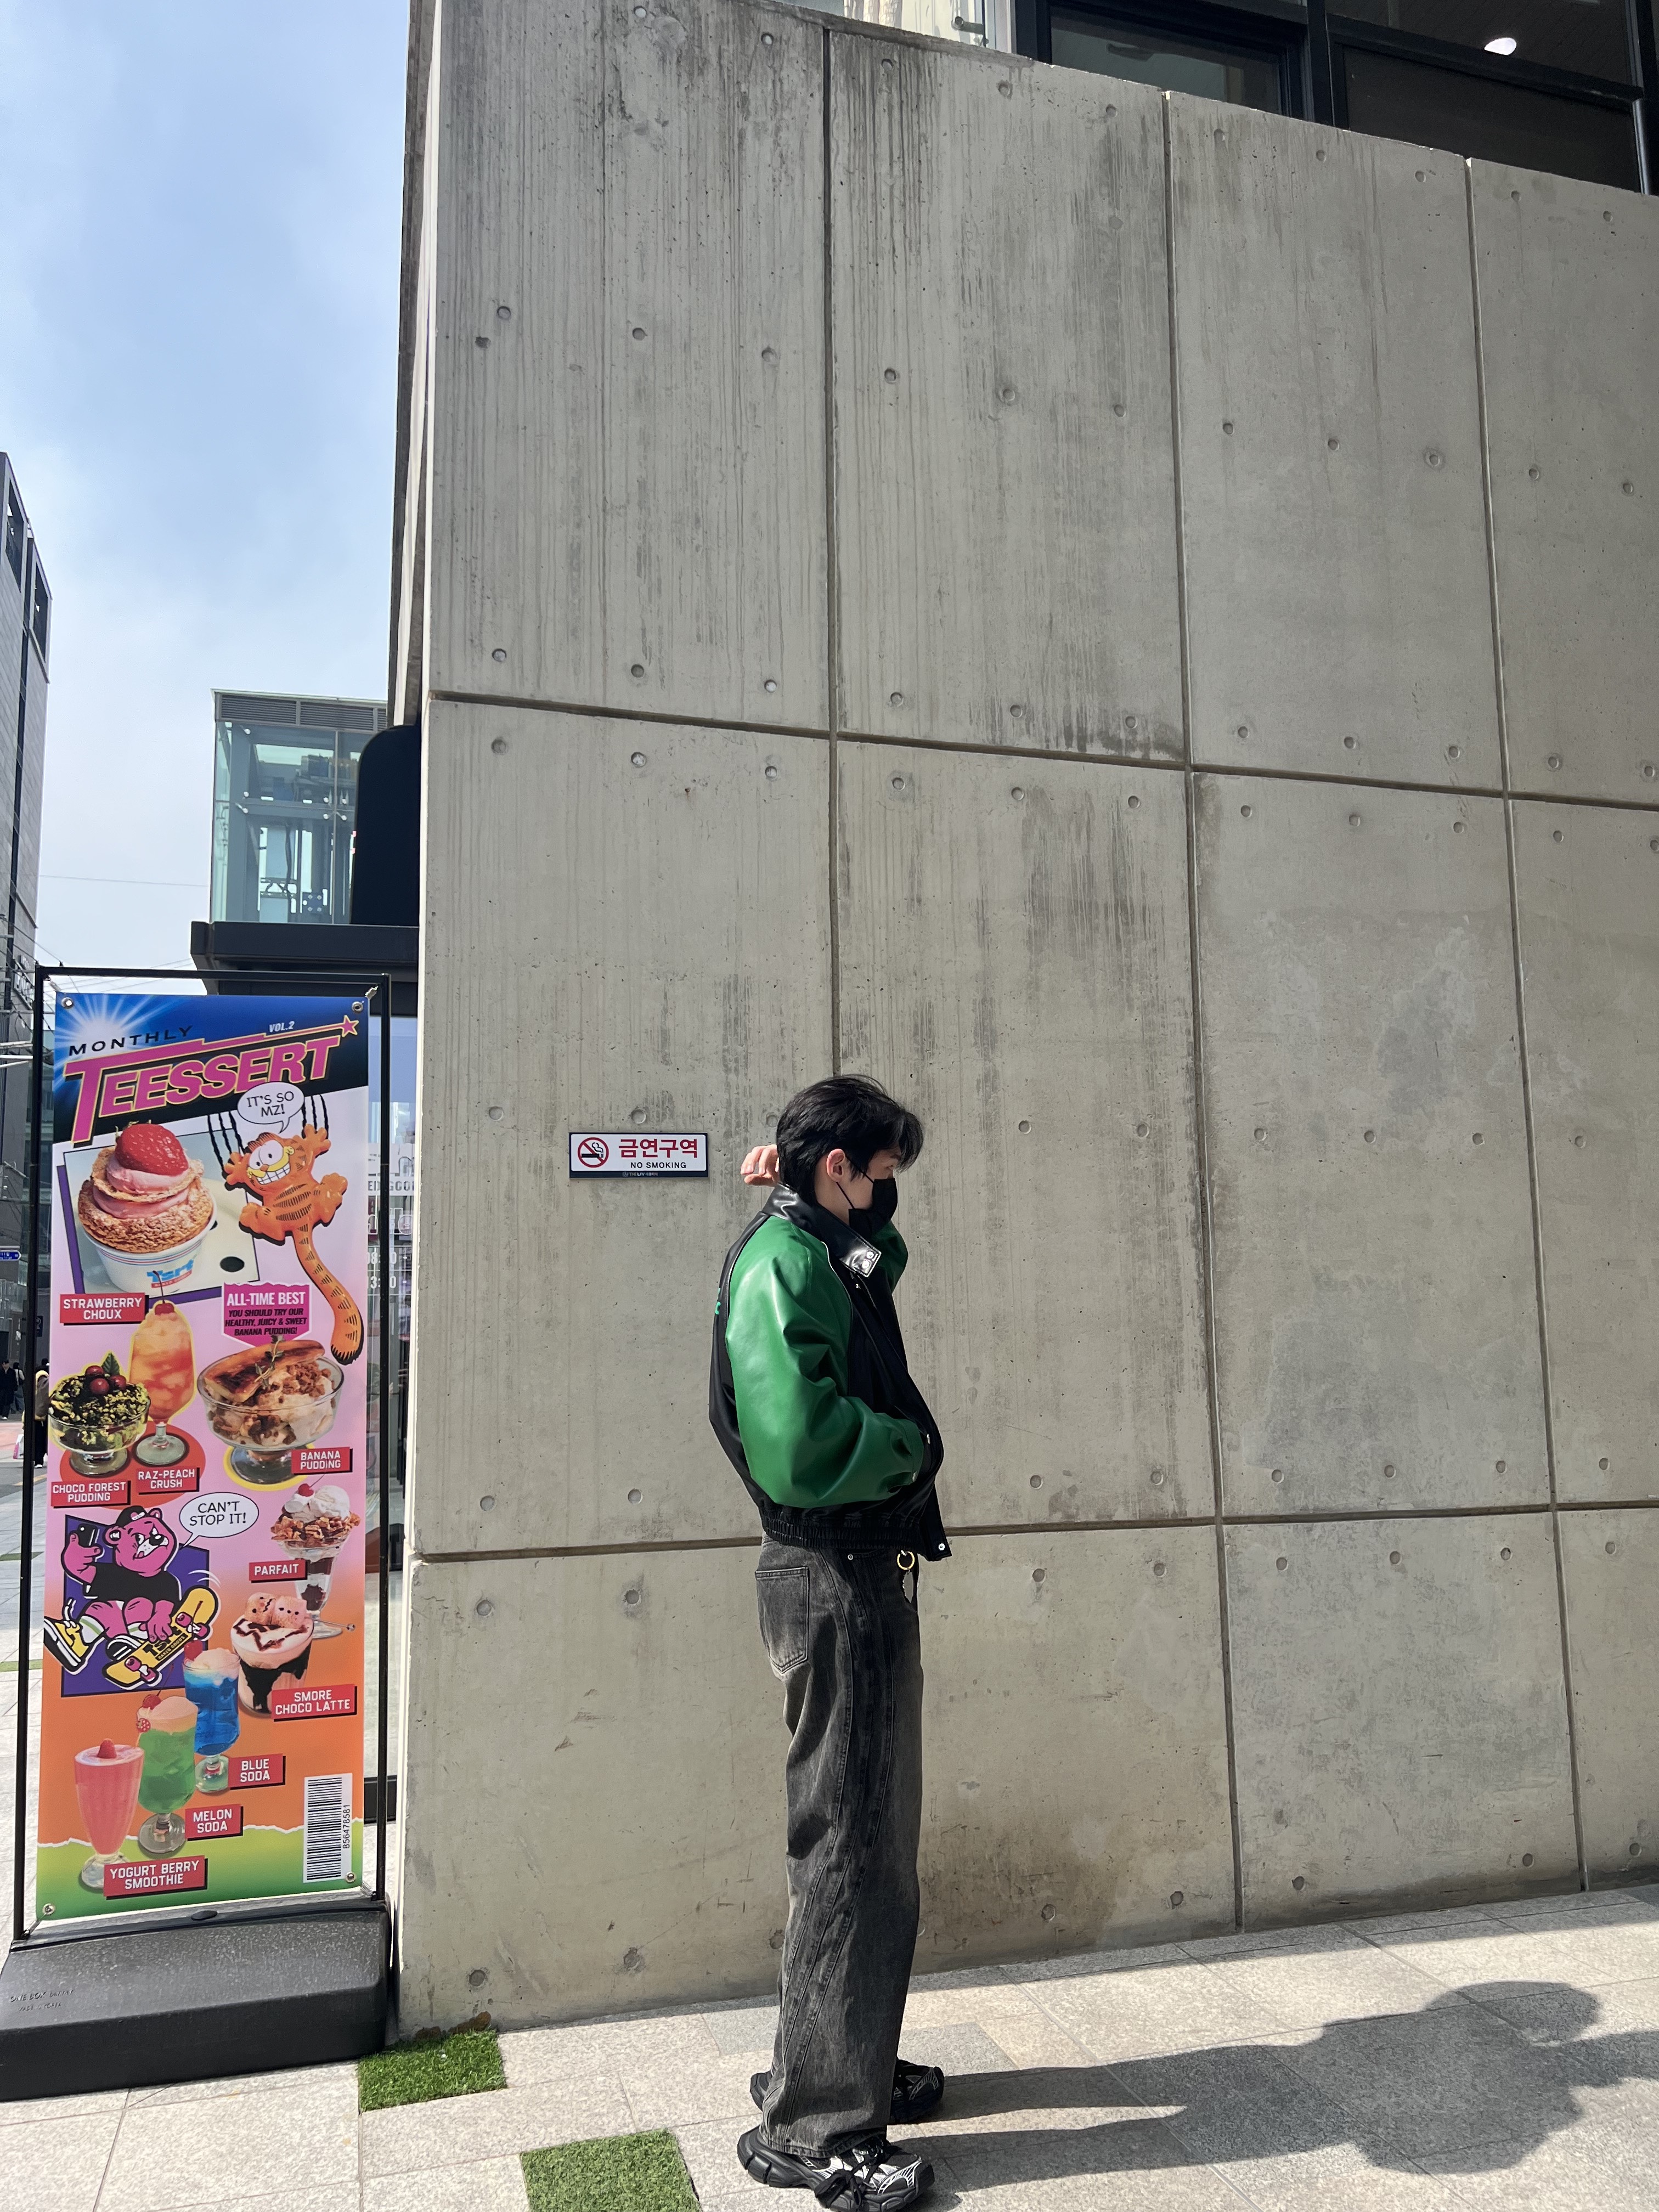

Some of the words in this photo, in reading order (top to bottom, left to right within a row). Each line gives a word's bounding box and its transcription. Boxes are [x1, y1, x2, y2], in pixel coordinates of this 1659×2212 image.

[269, 1020, 295, 1032] VOL.2
[69, 1025, 193, 1056] MONTHLY
[63, 1035, 341, 1143] TEESSERT
[247, 1094, 272, 1108] IT'S
[276, 1091, 294, 1103] SO
[261, 1103, 285, 1117] MZ!
[618, 1138, 697, 1158] 금연구역
[63, 1297, 142, 1309] STRAWBERRY
[227, 1292, 275, 1306] ALL-TIME
[278, 1291, 306, 1305] BEST
[83, 1309, 122, 1320] CHOUX
[228, 1309, 243, 1317] YOU
[244, 1308, 273, 1317] SHOULD
[285, 1317, 307, 1325] SWEET
[234, 1328, 262, 1336] BANANA
[264, 1327, 297, 1335] PUDDING!
[300, 1450, 341, 1461] BANANA
[300, 1459, 341, 1470] PUDDING
[138, 1469, 195, 1480] RAZ-PEACH
[53, 1484, 85, 1494] CHOCO
[88, 1482, 126, 1492] FOREST
[150, 1479, 183, 1489] CRUSH
[67, 1492, 111, 1503] PUDDING
[198, 1501, 240, 1514] CAN'T
[189, 1514, 225, 1526] STOP
[229, 1513, 246, 1525] IT!
[254, 1563, 300, 1576] PARFAIT
[294, 1689, 332, 1702] SMORE
[275, 1703, 312, 1715] CHOCO
[316, 1699, 351, 1712] LATTE
[241, 1758, 269, 1771] BLUE
[240, 1770, 270, 1782] SODA
[193, 1808, 232, 1822] MELON
[197, 1821, 228, 1833] SODA
[110, 1864, 157, 1879] YOGURT
[161, 1860, 199, 1874] BERRY
[125, 1873, 184, 1889] SMOOTHIE
[10, 1994, 27, 2002] ONE
